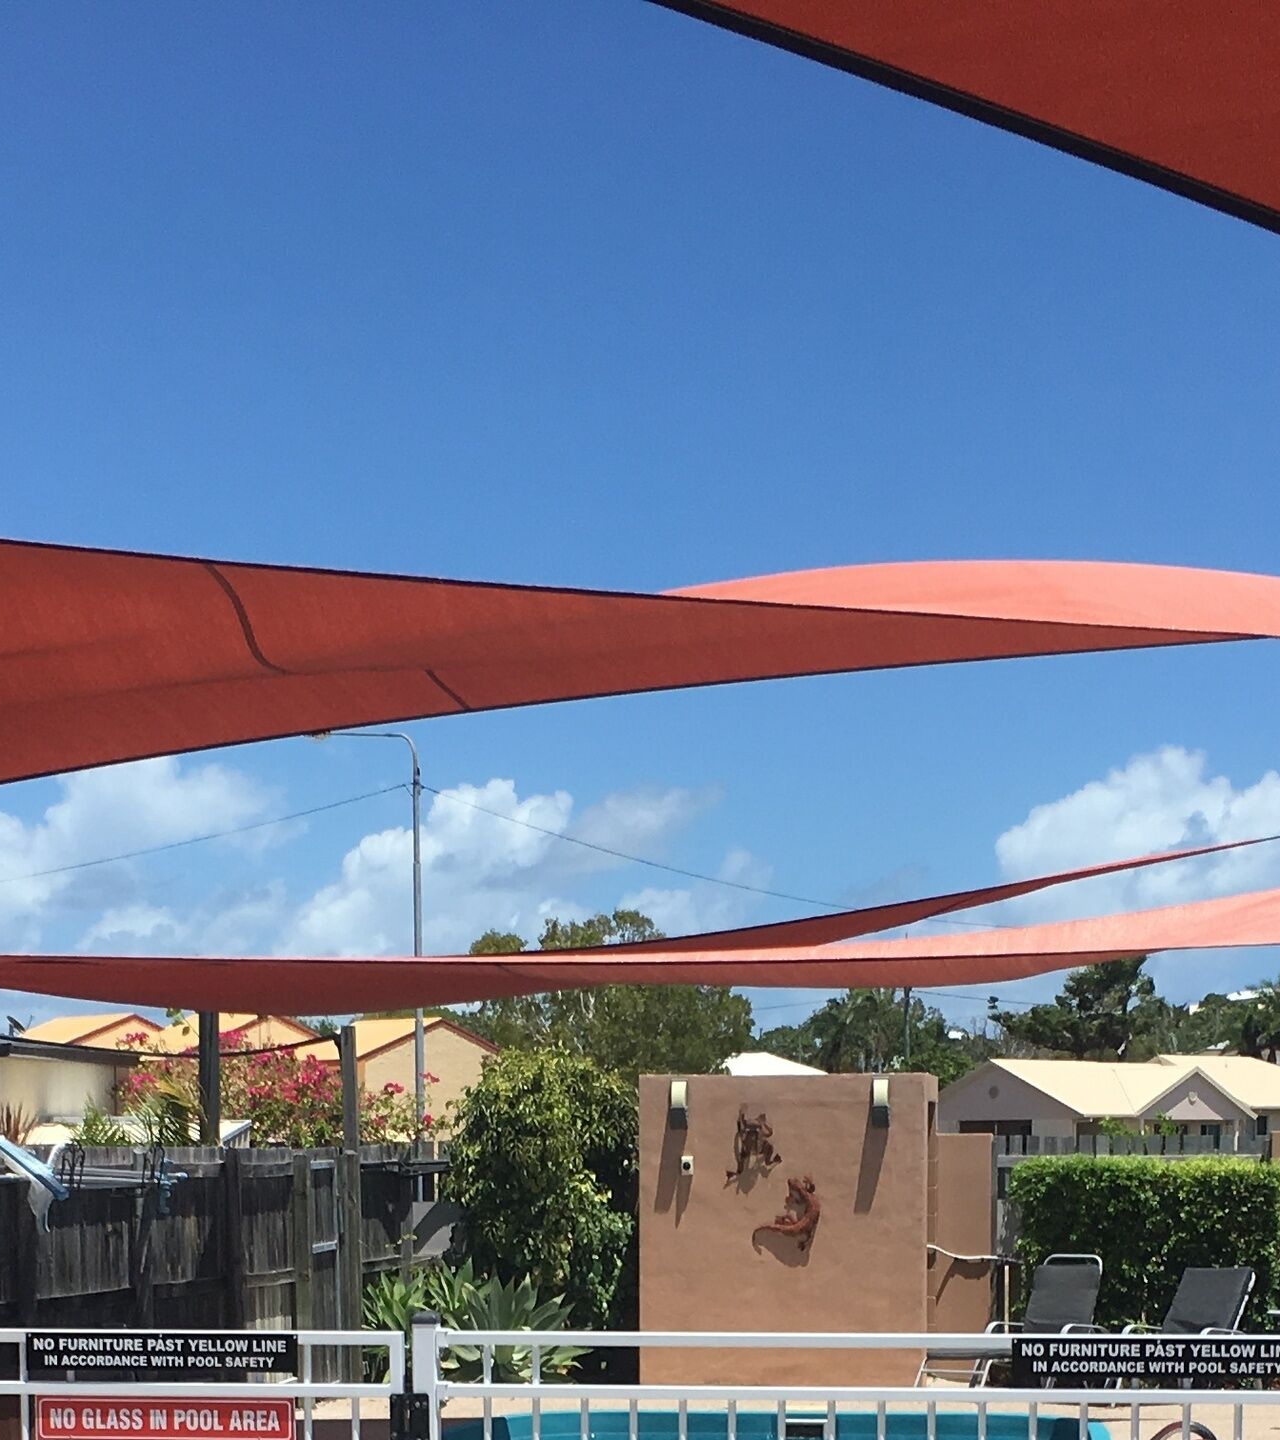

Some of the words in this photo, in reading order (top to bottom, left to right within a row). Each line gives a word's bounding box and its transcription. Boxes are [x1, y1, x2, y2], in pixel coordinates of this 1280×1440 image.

[33, 1338, 55, 1351] NO
[59, 1338, 143, 1352] FURNITURE
[147, 1339, 184, 1352] PAST
[188, 1339, 249, 1353] YELLOW
[252, 1339, 287, 1353] LINE
[1021, 1343, 1045, 1357] NO
[1049, 1343, 1141, 1358] FURNITURE
[1145, 1344, 1185, 1358] PAST
[1190, 1344, 1257, 1358] YELLOW
[44, 1355, 57, 1366] IN
[61, 1355, 147, 1367] ACCORDANCE
[151, 1356, 184, 1368] WITH
[187, 1356, 222, 1368] POOL
[225, 1357, 274, 1369] SAFETY
[1033, 1361, 1047, 1373] IN
[1051, 1361, 1145, 1373] ACCORDANCE
[1148, 1361, 1184, 1374] WITH
[1188, 1362, 1226, 1374] POOL
[49, 1407, 76, 1429] NO
[82, 1408, 143, 1431] GLASS
[149, 1409, 167, 1431] IN
[174, 1409, 223, 1432] POOL
[229, 1410, 281, 1432] AREA
